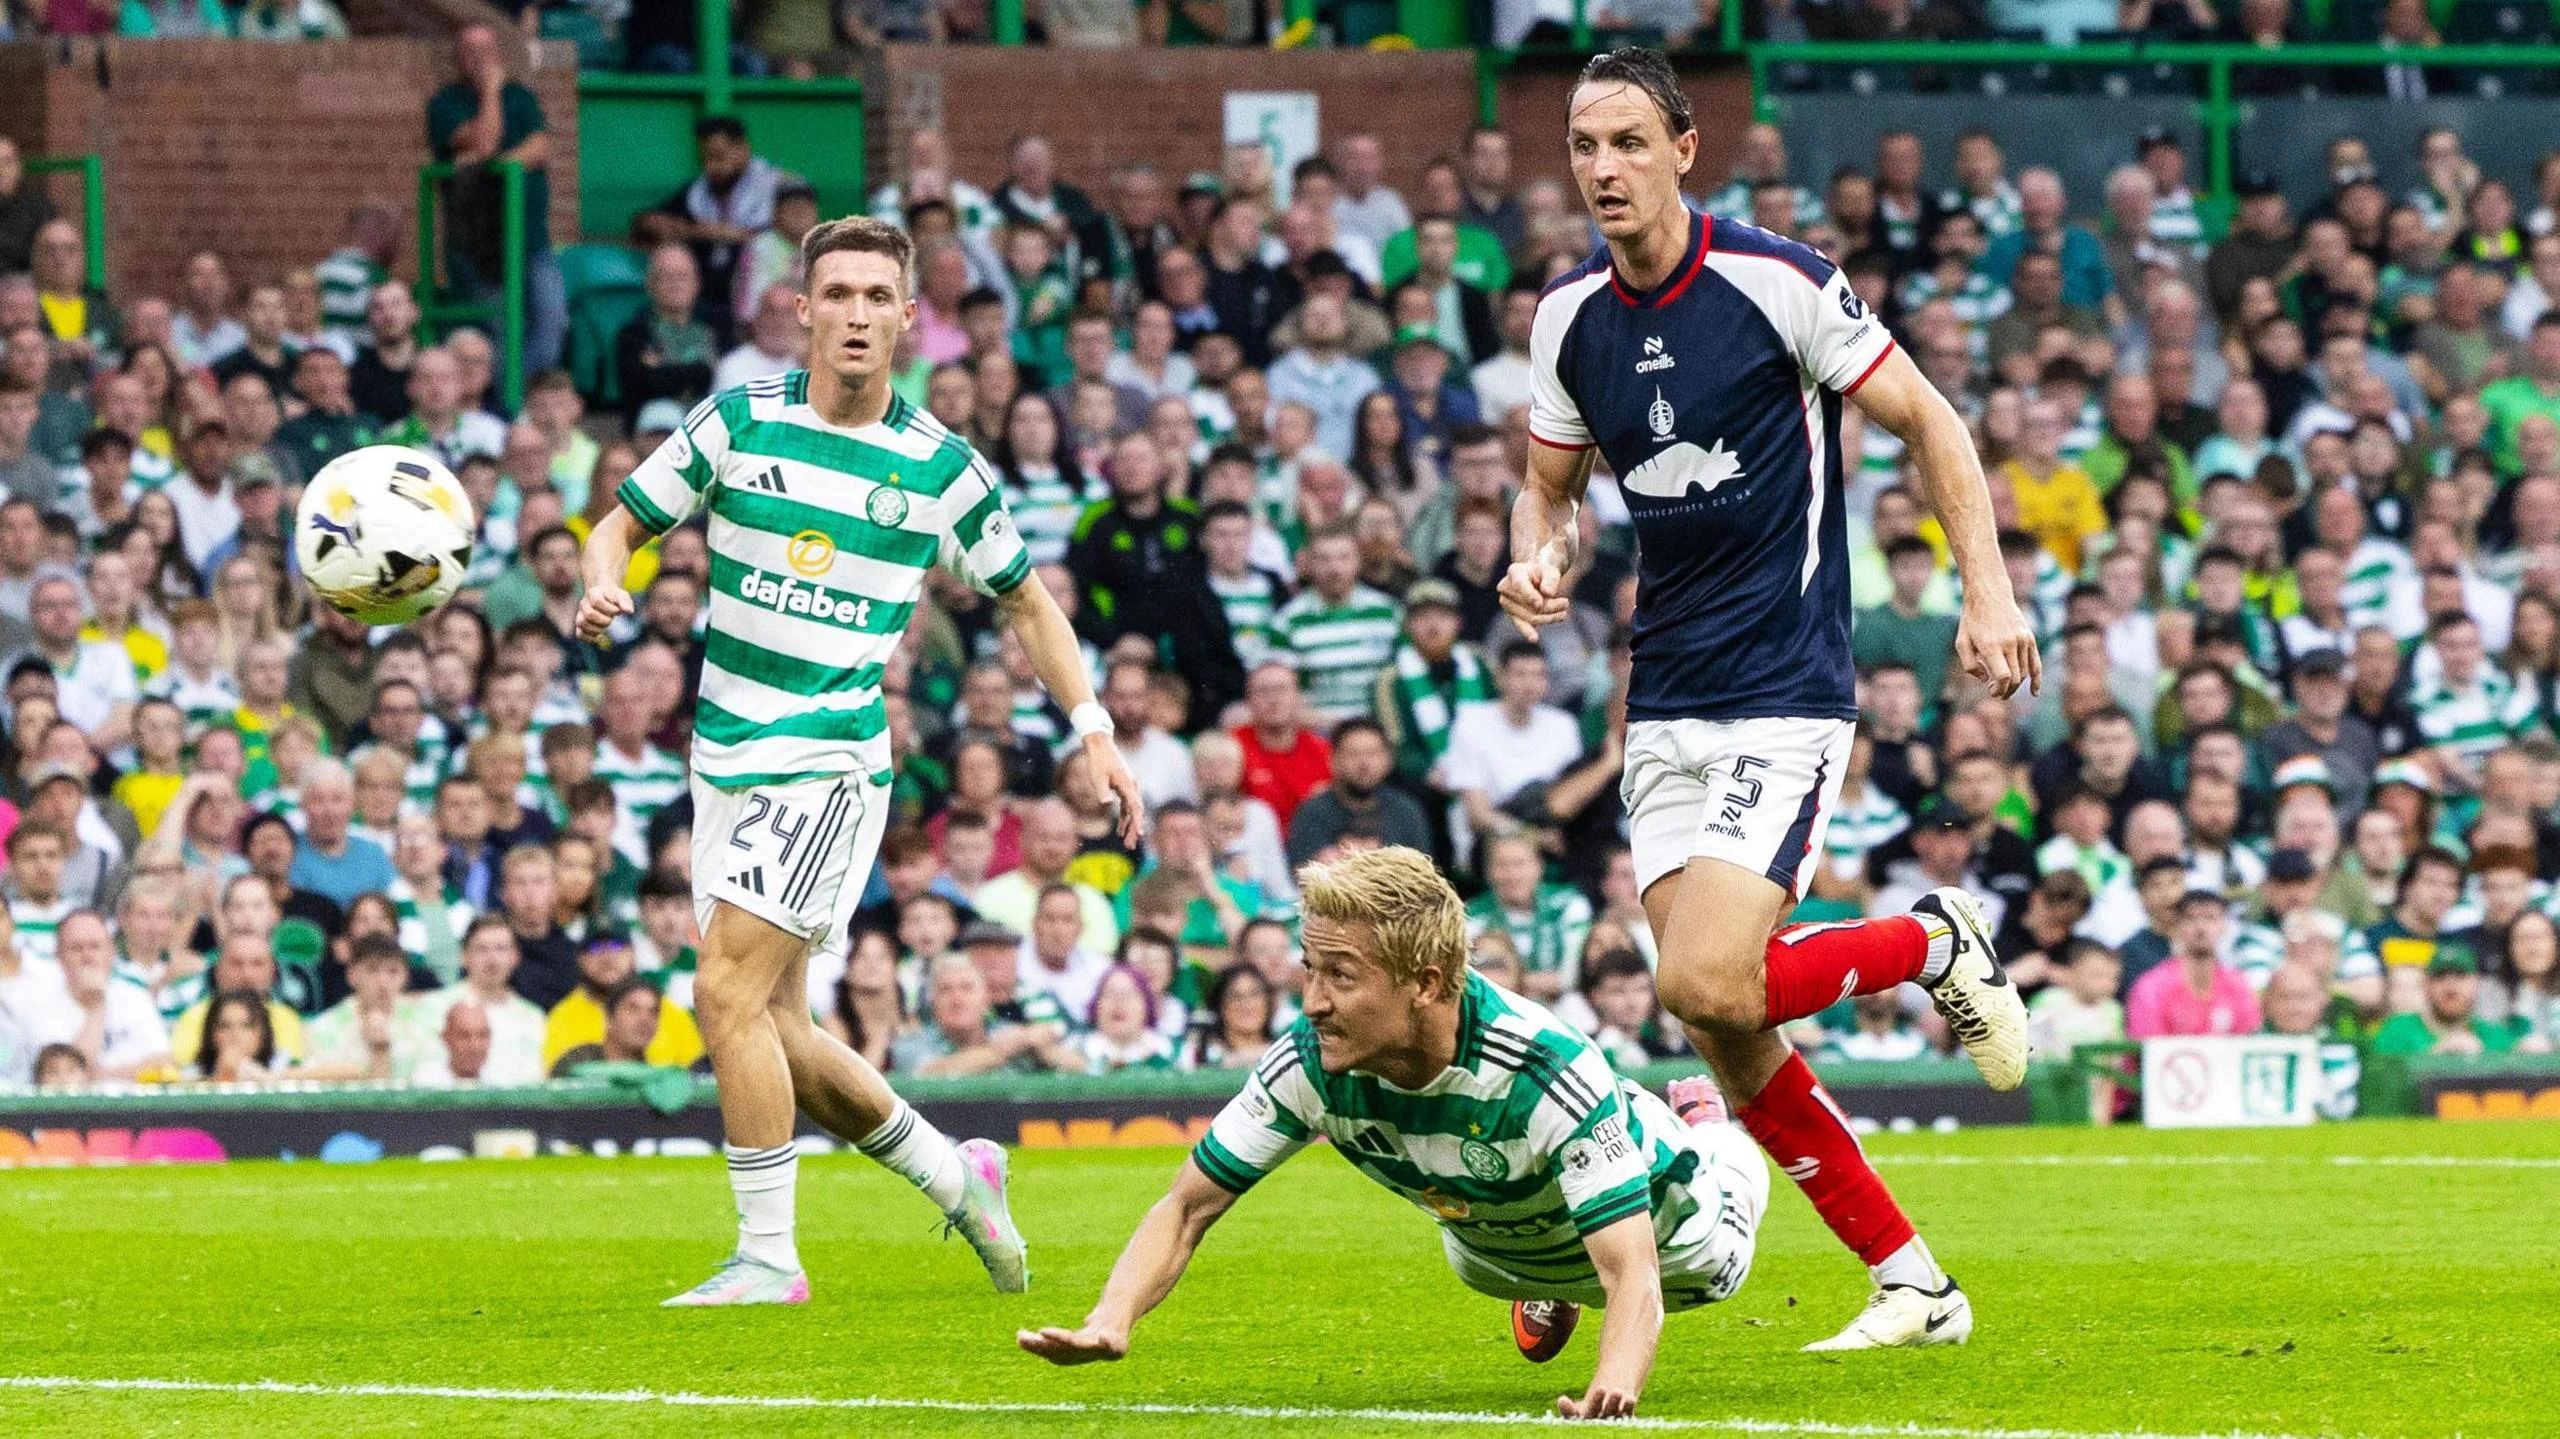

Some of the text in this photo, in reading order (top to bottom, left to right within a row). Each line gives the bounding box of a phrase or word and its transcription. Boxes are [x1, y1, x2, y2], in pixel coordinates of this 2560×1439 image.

[740, 569, 871, 628] dafabet
[1723, 755, 1772, 808] 5
[730, 793, 809, 867] 24
